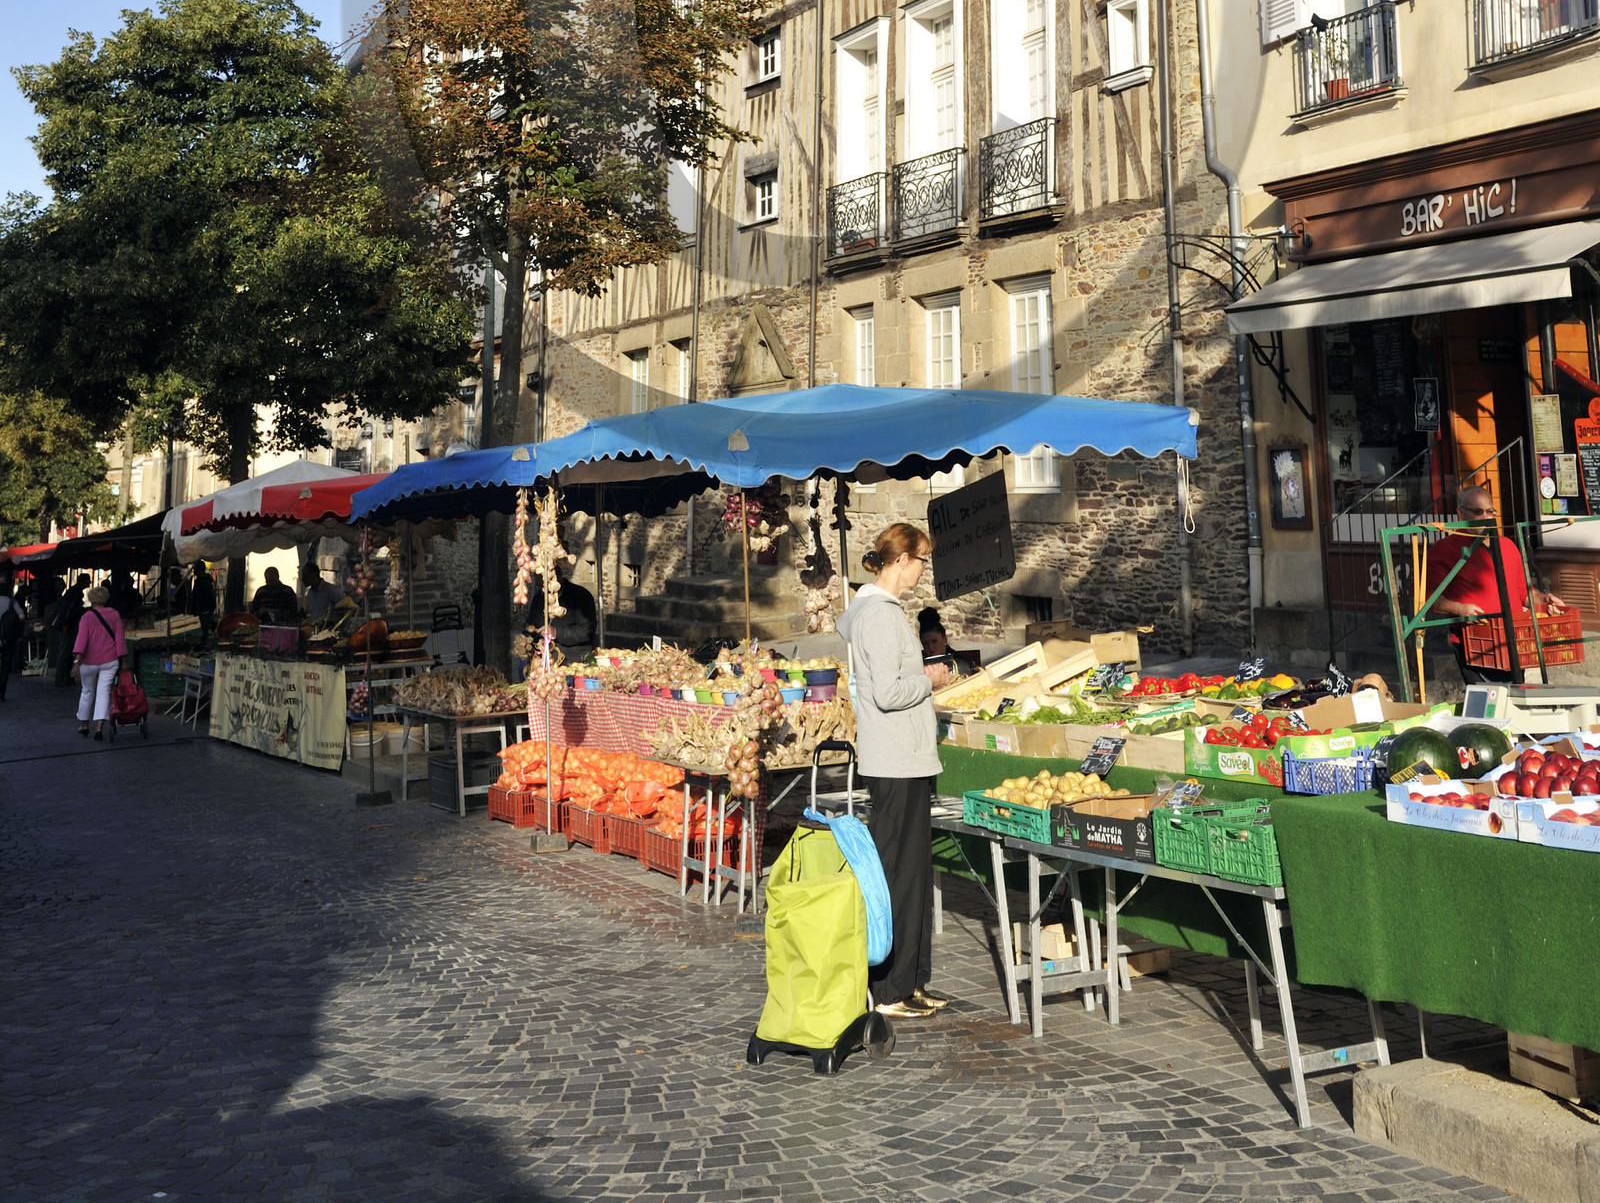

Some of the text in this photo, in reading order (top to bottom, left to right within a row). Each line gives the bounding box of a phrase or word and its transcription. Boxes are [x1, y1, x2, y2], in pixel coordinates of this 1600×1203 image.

[1368, 562, 1411, 597] BR
[1220, 755, 1252, 771] Savéol
[1086, 822, 1122, 835] Le Jardin
